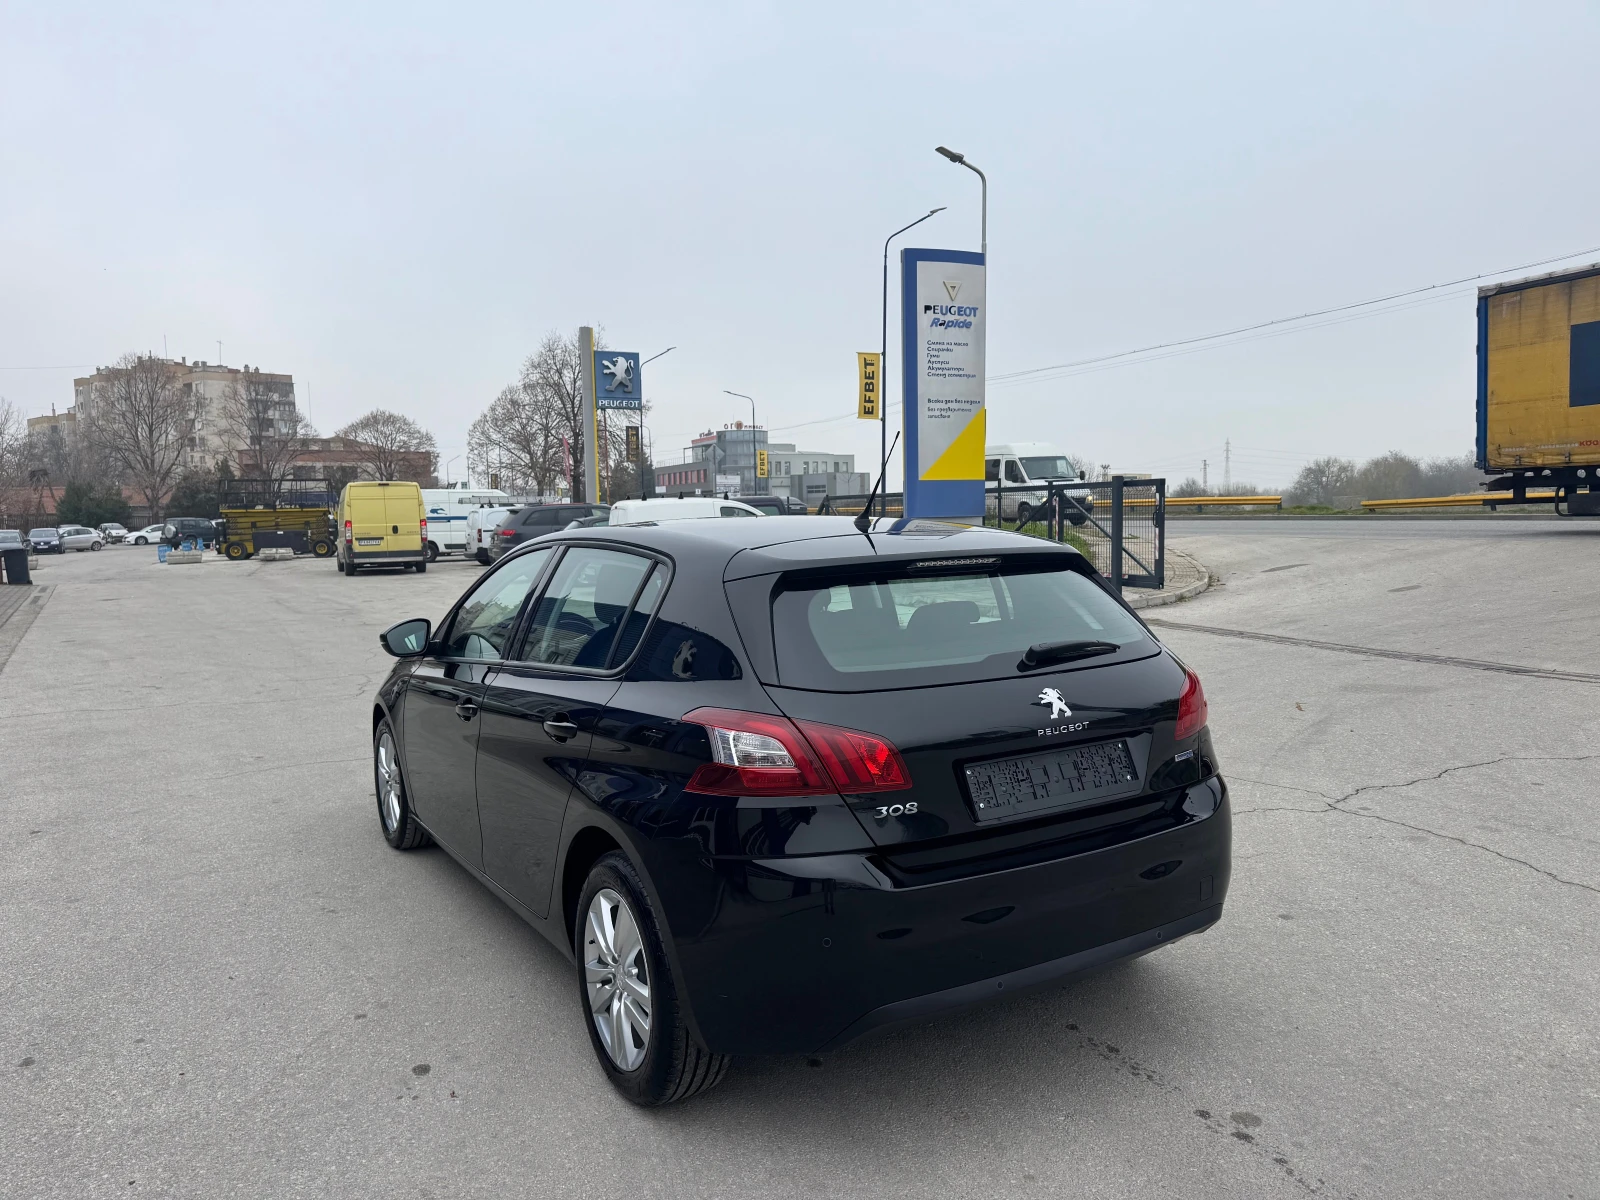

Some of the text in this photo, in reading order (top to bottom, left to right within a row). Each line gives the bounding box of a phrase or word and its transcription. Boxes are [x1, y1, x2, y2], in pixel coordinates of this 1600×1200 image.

[924, 304, 978, 317] PEUGEOT
[930, 317, 972, 330] Rapide
[863, 356, 875, 415] EFBET
[598, 399, 640, 408] PEUGEOT
[1037, 721, 1090, 737] PEUGEOT
[873, 801, 918, 819] 308
